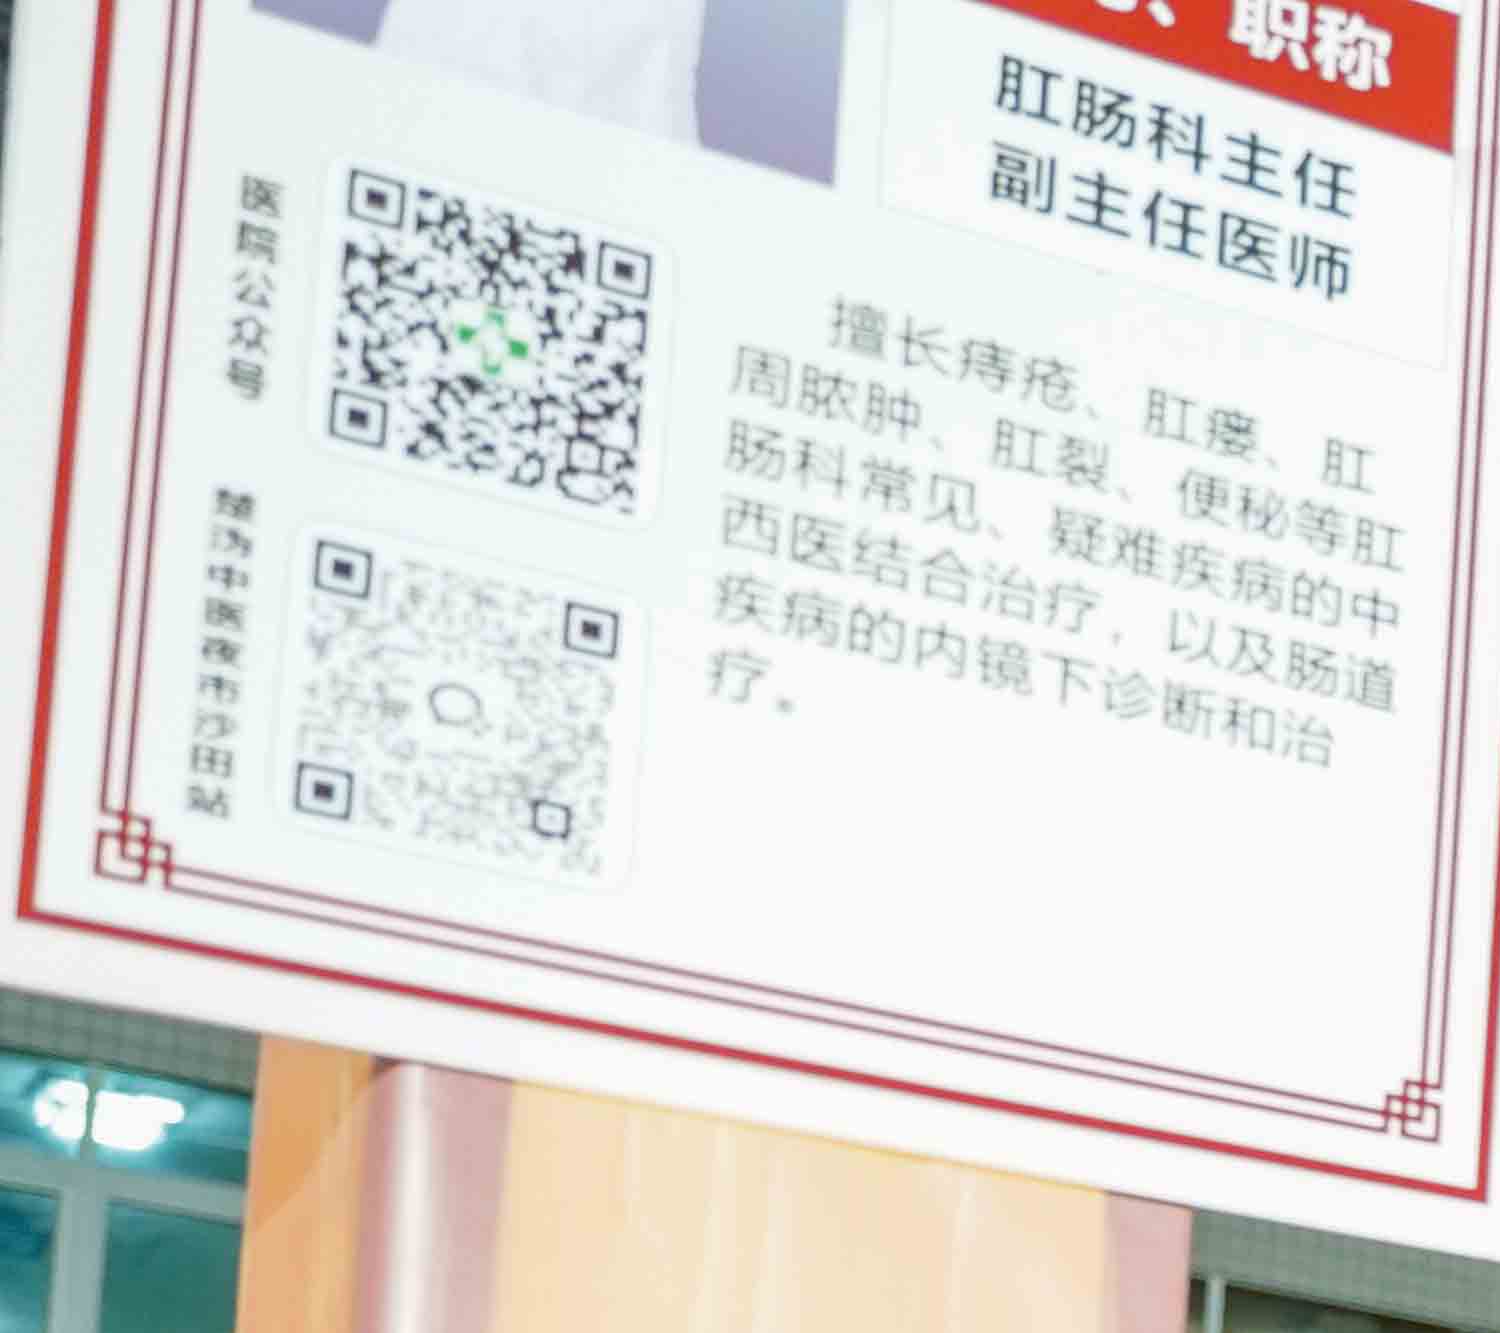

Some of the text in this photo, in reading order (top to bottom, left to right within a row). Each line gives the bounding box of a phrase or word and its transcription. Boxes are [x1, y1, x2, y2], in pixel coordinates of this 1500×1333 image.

[994, 51, 1359, 221] 肛肠科主任
[1095, 0, 1393, 92] 、职称
[226, 174, 286, 402] 医院公众号
[989, 139, 1353, 302] 副主任医师
[727, 341, 1407, 574] 周脓肿、肛裂、便秘等肛
[828, 295, 1376, 496] 擅长痔疮、肛瘘、肛
[723, 418, 1400, 643] 肠科常见、疑难疾病的中
[706, 648, 796, 714] 疗。
[711, 569, 1335, 768] 疾病的内镜下诊断和治
